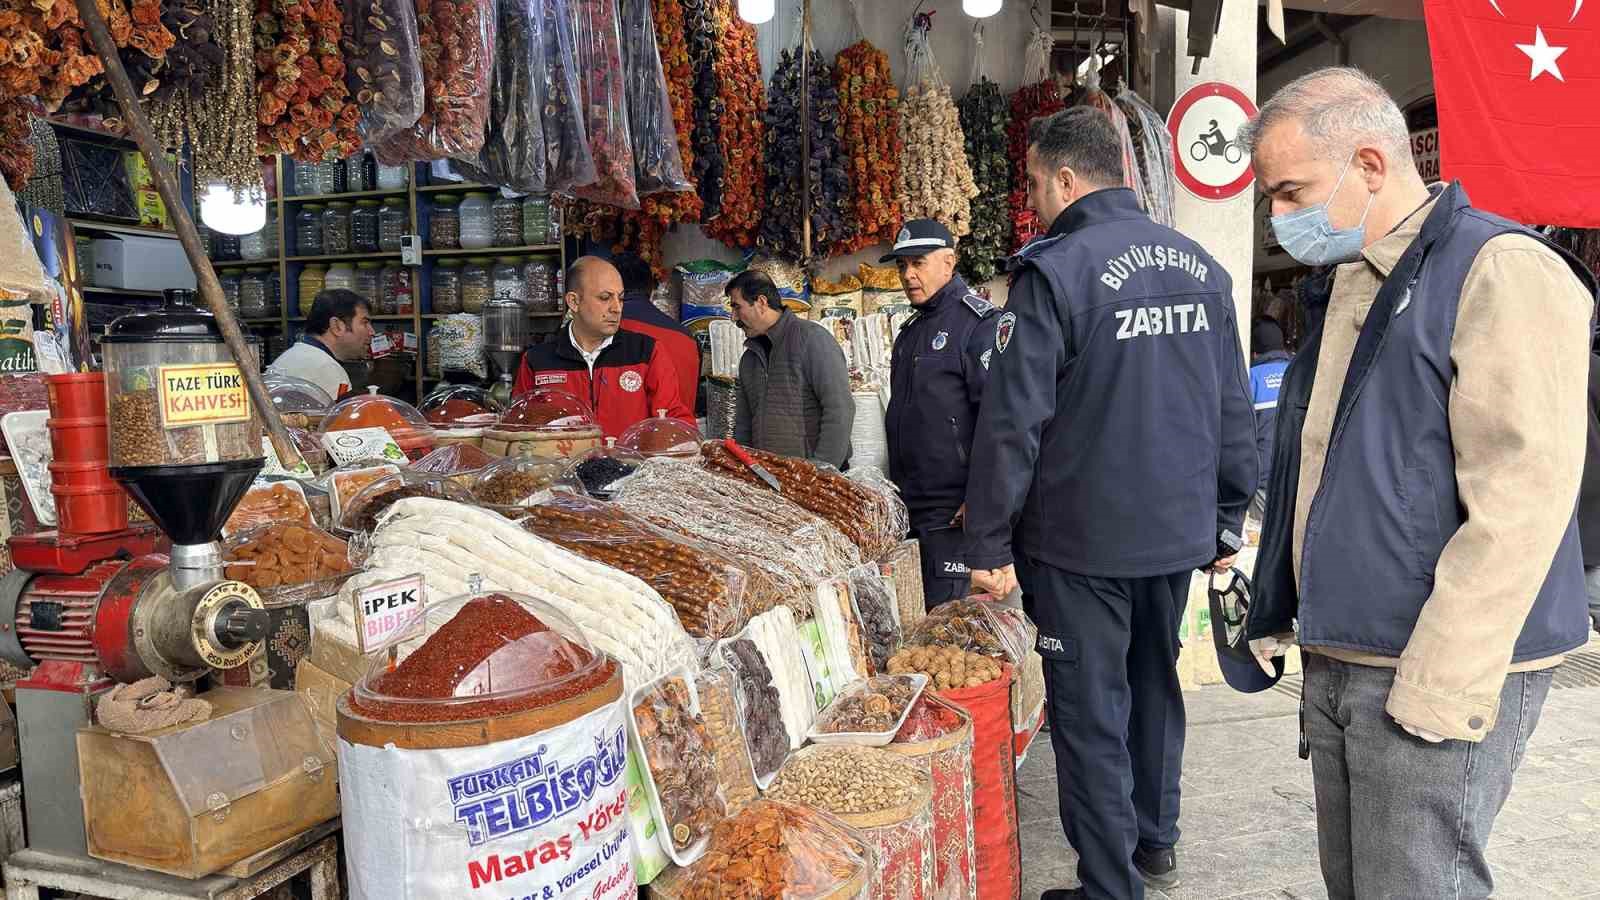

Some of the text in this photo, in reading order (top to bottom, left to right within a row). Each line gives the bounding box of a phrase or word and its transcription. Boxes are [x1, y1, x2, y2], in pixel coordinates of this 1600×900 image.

[1115, 303, 1210, 340] ZABITA
[0, 346, 34, 371] atih
[168, 372, 241, 392] TAZE TÜRK
[468, 833, 573, 889] Maraş
[556, 852, 601, 893] Yöresel
